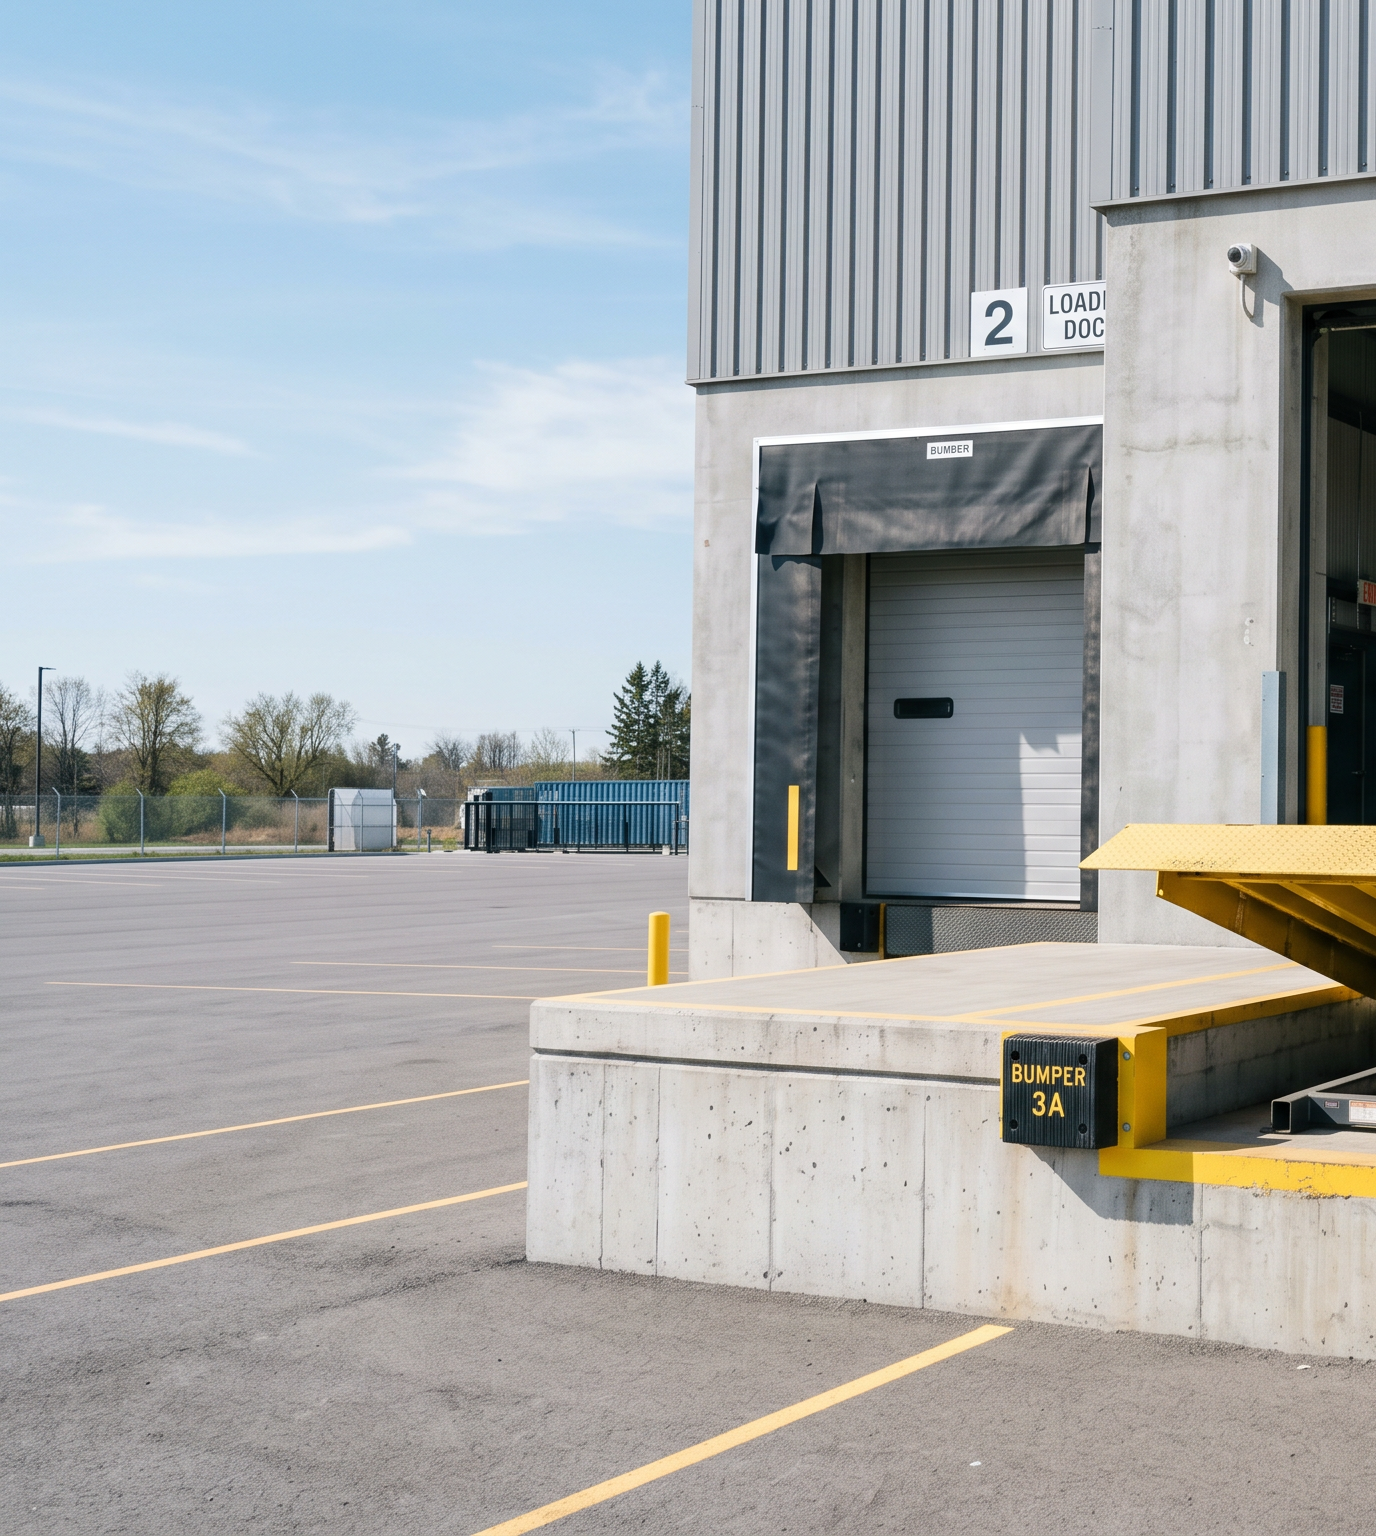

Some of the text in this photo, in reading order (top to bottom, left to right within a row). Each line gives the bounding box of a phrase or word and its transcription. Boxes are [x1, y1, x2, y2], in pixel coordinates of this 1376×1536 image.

[984, 299, 1014, 346] 2
[1064, 317, 1105, 340] DOC
[930, 444, 970, 455] BUMBER
[1011, 1063, 1086, 1087] BUMPER
[1032, 1091, 1065, 1118] 3A
